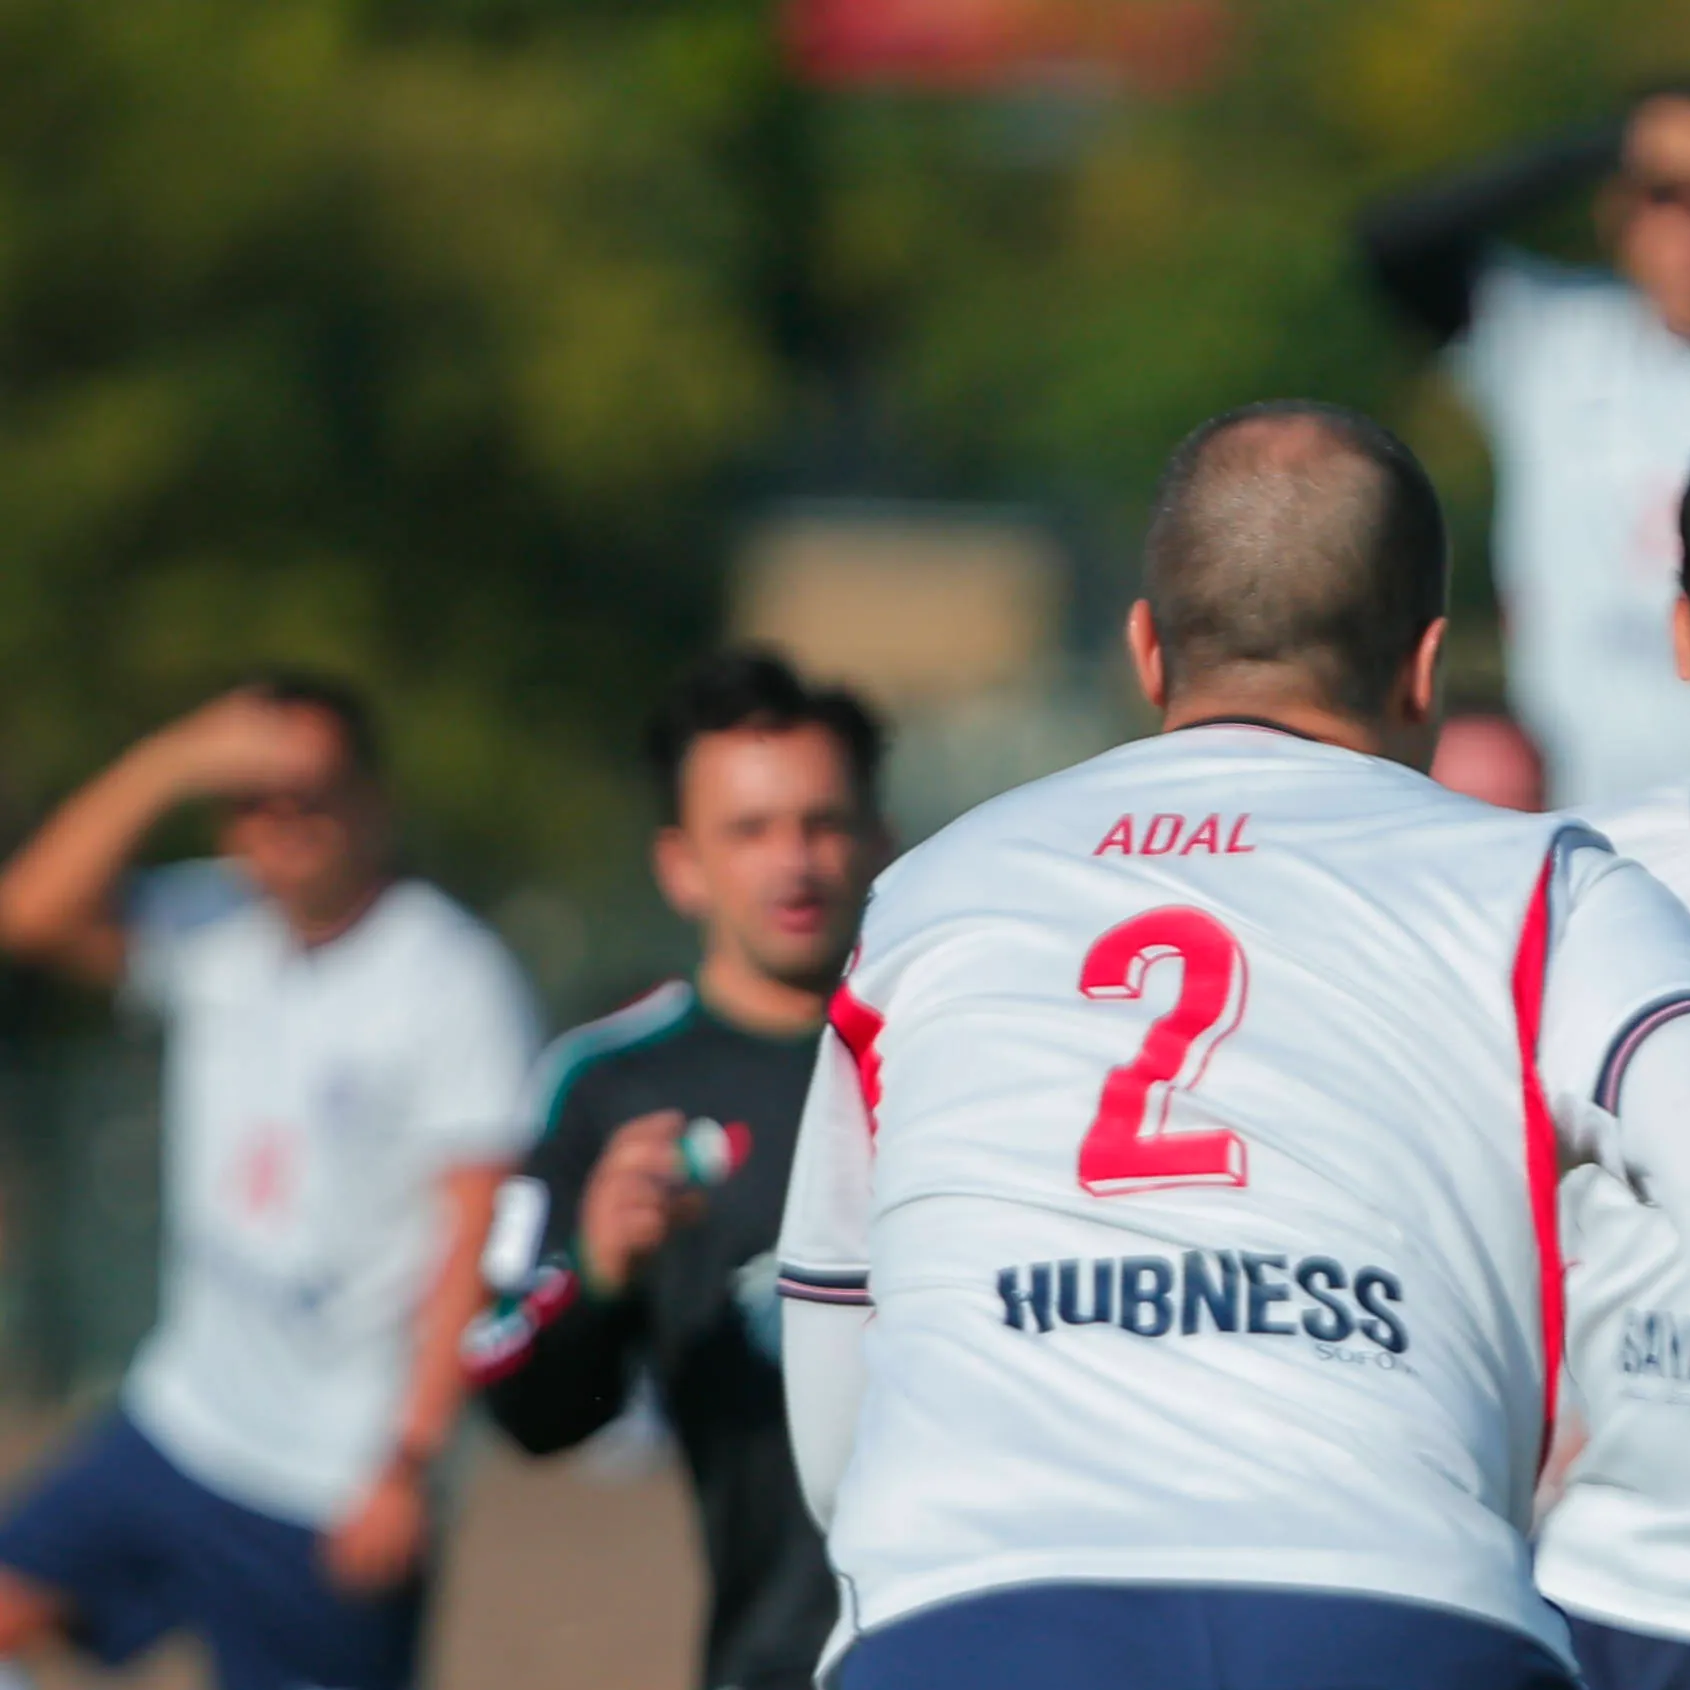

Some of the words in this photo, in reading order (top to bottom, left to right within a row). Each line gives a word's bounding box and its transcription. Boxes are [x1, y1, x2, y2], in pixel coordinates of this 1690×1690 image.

[1093, 812, 1257, 856] ADAL
[1077, 904, 1248, 1198] 2
[997, 1249, 1410, 1354] HUBNESS
